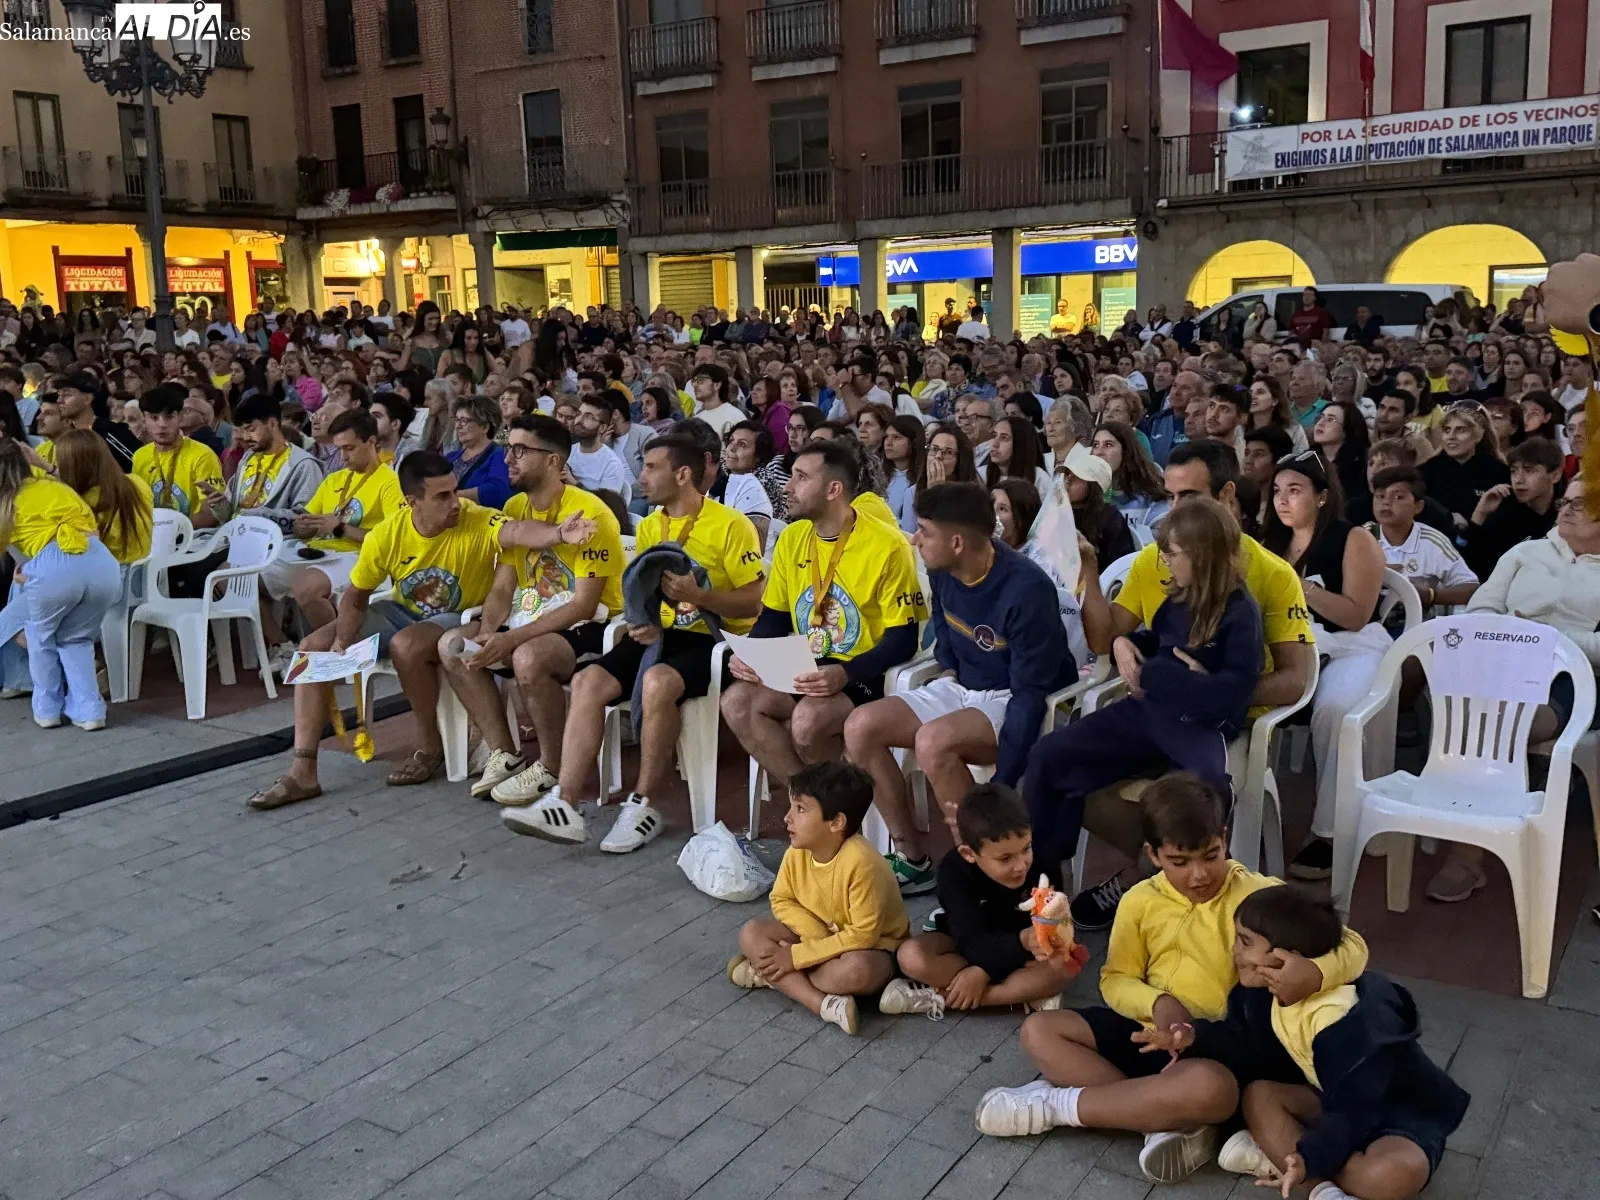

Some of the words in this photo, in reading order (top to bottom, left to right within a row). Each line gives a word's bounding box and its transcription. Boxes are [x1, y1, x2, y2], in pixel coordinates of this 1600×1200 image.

[1300, 130, 1332, 145] POR
[1337, 127, 1357, 141] LA
[1361, 117, 1454, 139] SEGURIDAD
[1459, 114, 1481, 128] DE
[1486, 111, 1518, 127] LOS
[1523, 103, 1600, 122] VECINOS
[1274, 148, 1328, 169] EXIGIMOS
[1329, 147, 1338, 164] A
[1339, 145, 1353, 163] LA
[1355, 136, 1425, 161] DIPUTACIÓN
[1427, 136, 1443, 155] DE
[1445, 130, 1519, 153] SALAMANCA
[1522, 128, 1540, 147] UN
[1542, 123, 1593, 145] PARQUE
[1095, 243, 1138, 264] BBV
[64, 266, 123, 278] LIQUIDACIÓN
[170, 268, 222, 279] LIQUIDACIÓN
[885, 256, 919, 277] BVA
[65, 280, 125, 292] TOTAL
[169, 281, 225, 293] TOTAL
[582, 547, 609, 562] rtve
[741, 550, 763, 565] rtv
[805, 585, 850, 606] GND
[896, 591, 925, 607] rtve
[1287, 603, 1309, 620] rtv
[1474, 631, 1541, 644] RESERVADO
